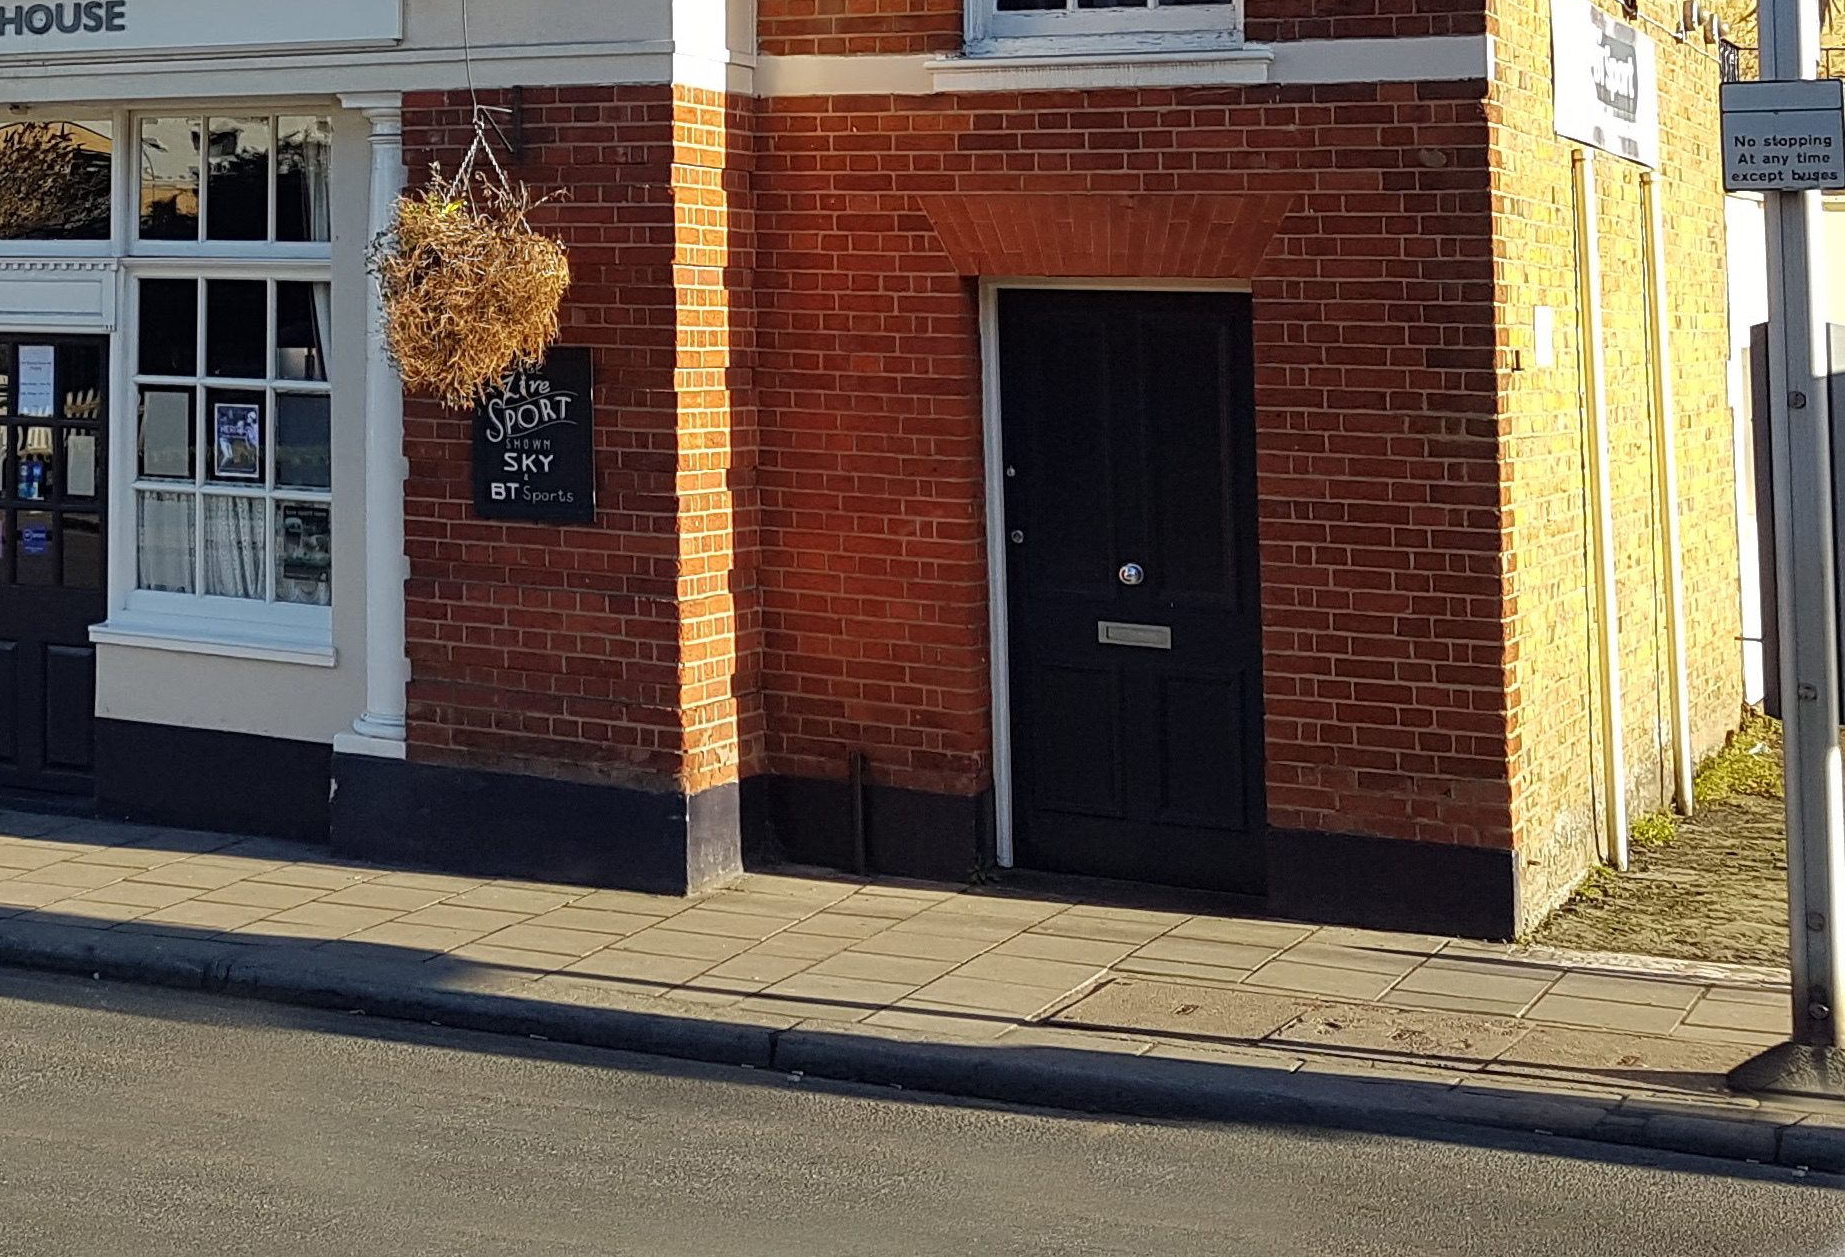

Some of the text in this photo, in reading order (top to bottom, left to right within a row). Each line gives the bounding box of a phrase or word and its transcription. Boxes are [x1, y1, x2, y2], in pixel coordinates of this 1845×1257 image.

[1734, 134, 1832, 148] No stopping
[1737, 152, 1831, 166] At any time
[1731, 169, 1838, 183] except buses
[486, 396, 572, 443] SPORT
[506, 438, 551, 450] SHOWN
[503, 452, 554, 473] SKY
[491, 482, 575, 504] BT Sports
